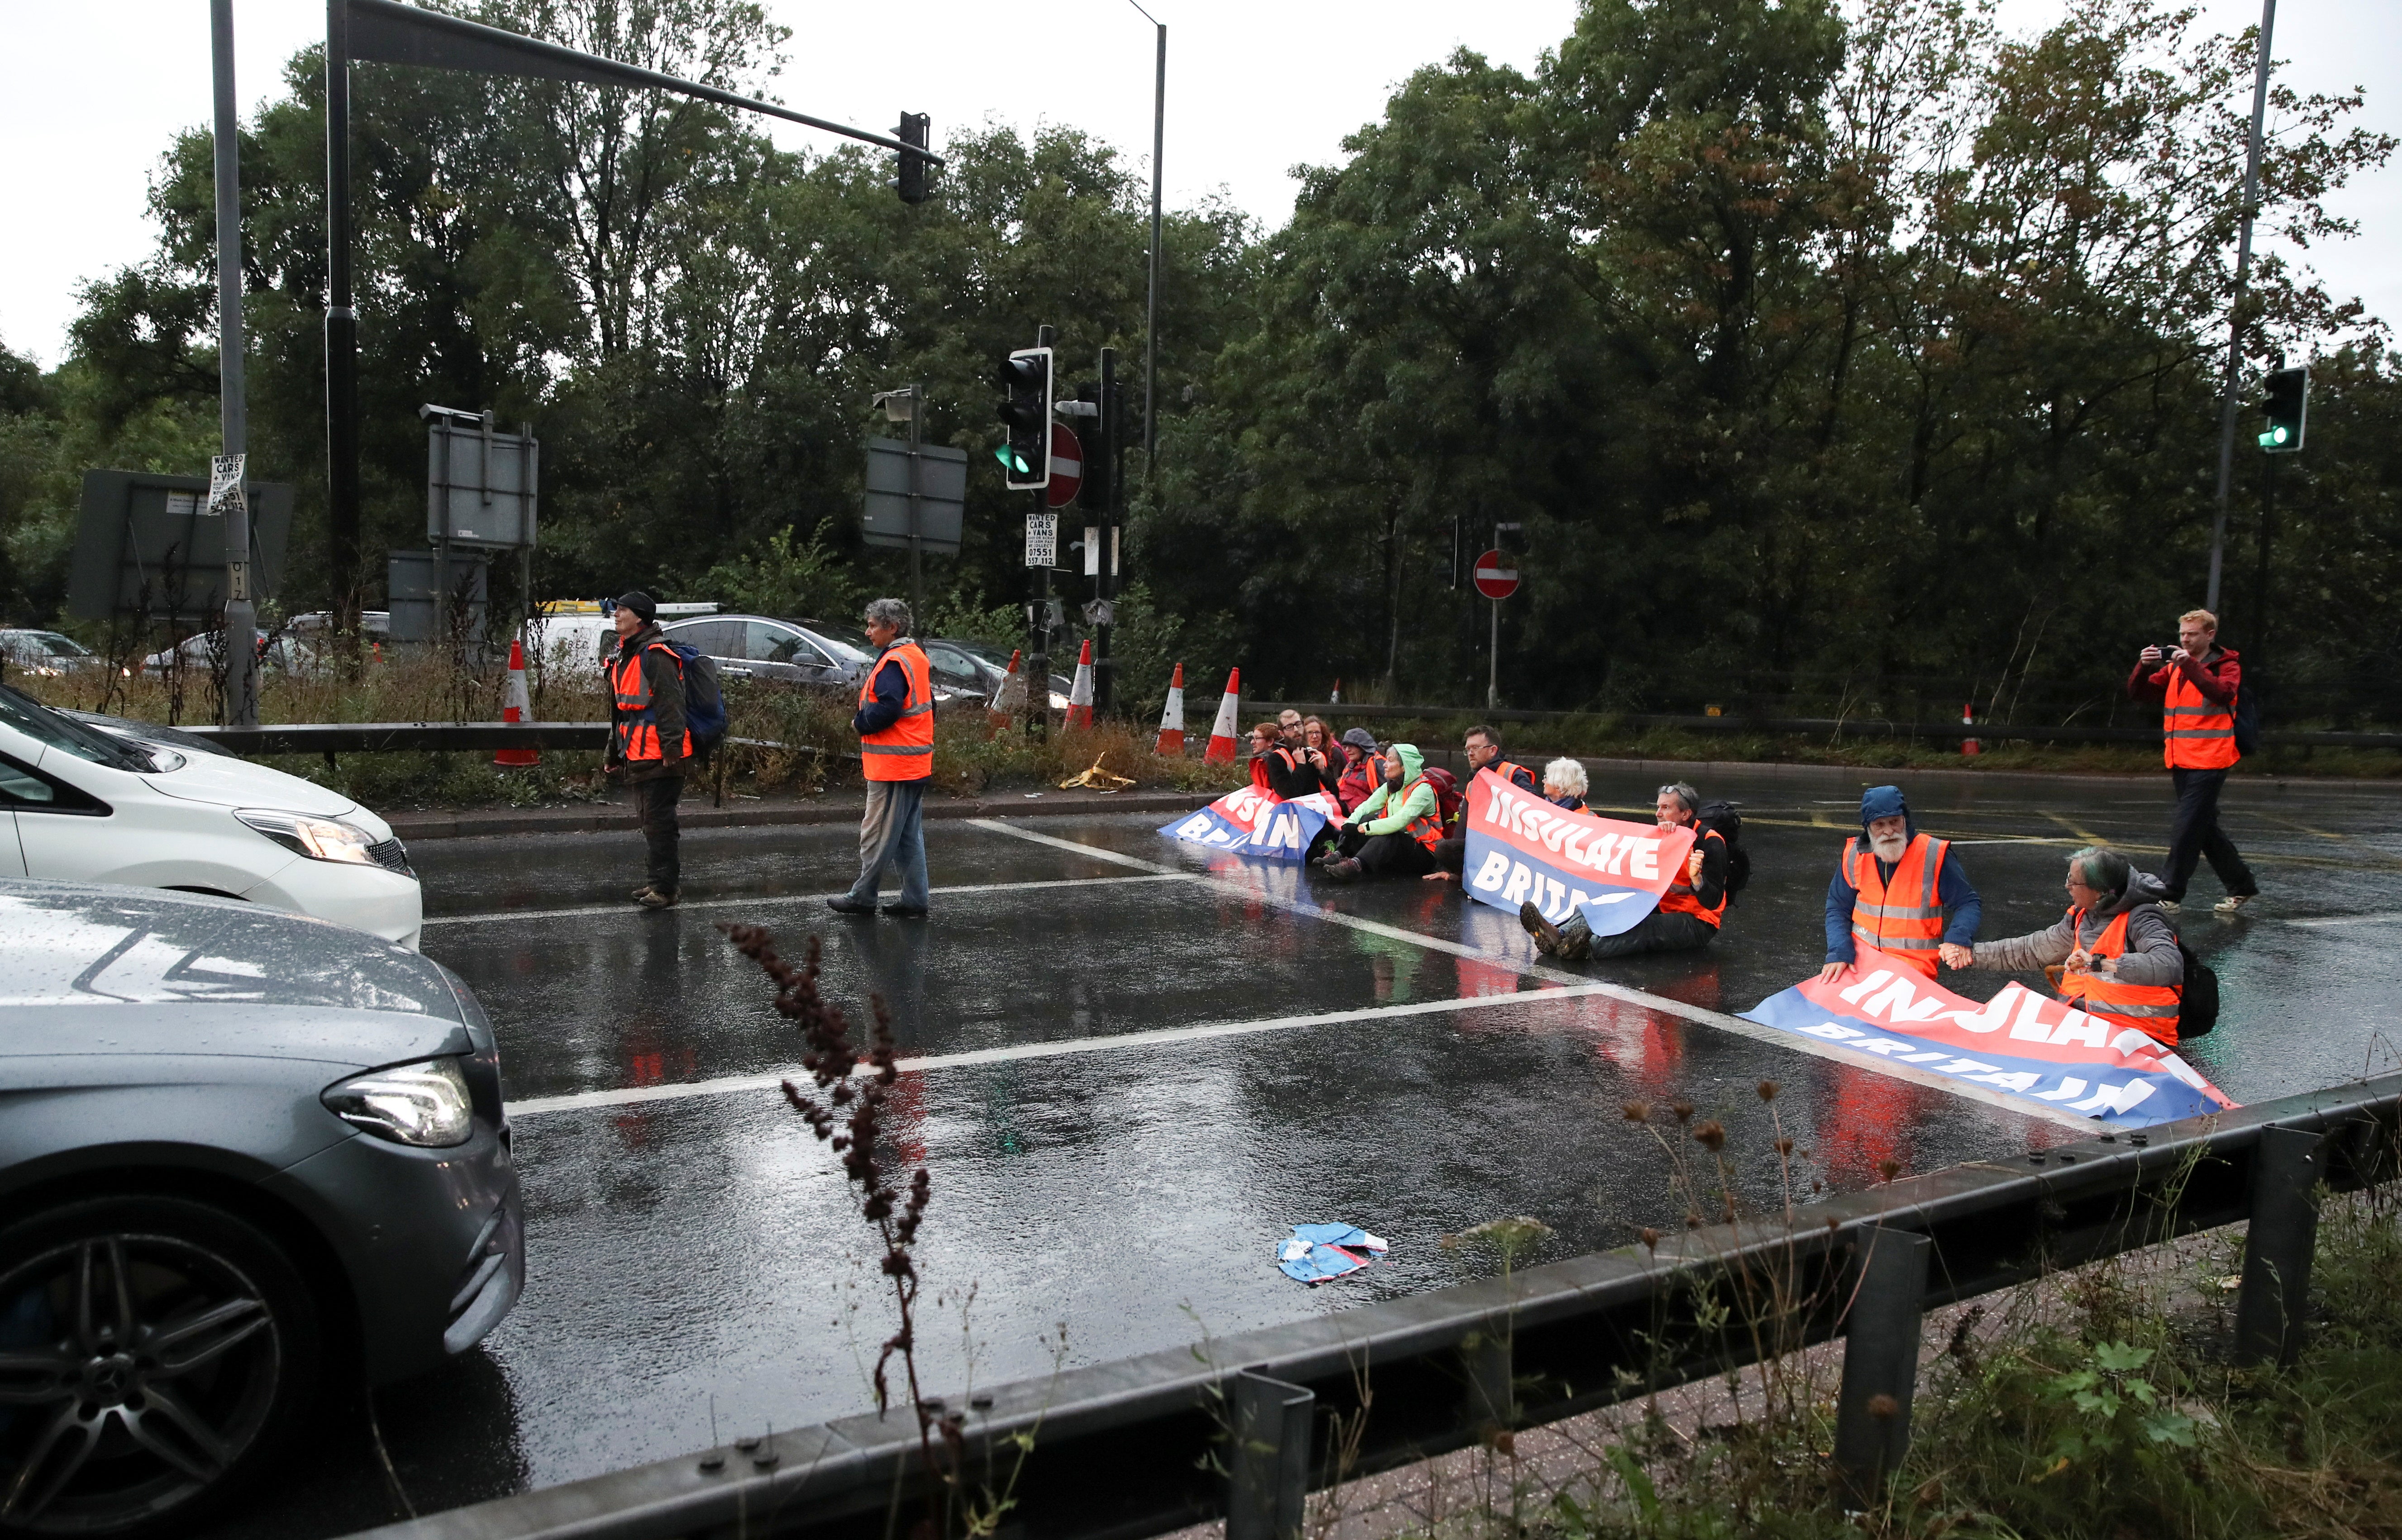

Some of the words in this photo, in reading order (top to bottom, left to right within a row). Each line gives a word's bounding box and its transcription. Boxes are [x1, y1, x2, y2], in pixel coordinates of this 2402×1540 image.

[214, 455, 243, 464] WANTED
[217, 463, 239, 473] CARS
[231, 501, 243, 510] 112
[1029, 521, 1051, 529] CARS
[1029, 548, 1052, 556] 07551
[1485, 785, 1663, 880] INSULATE
